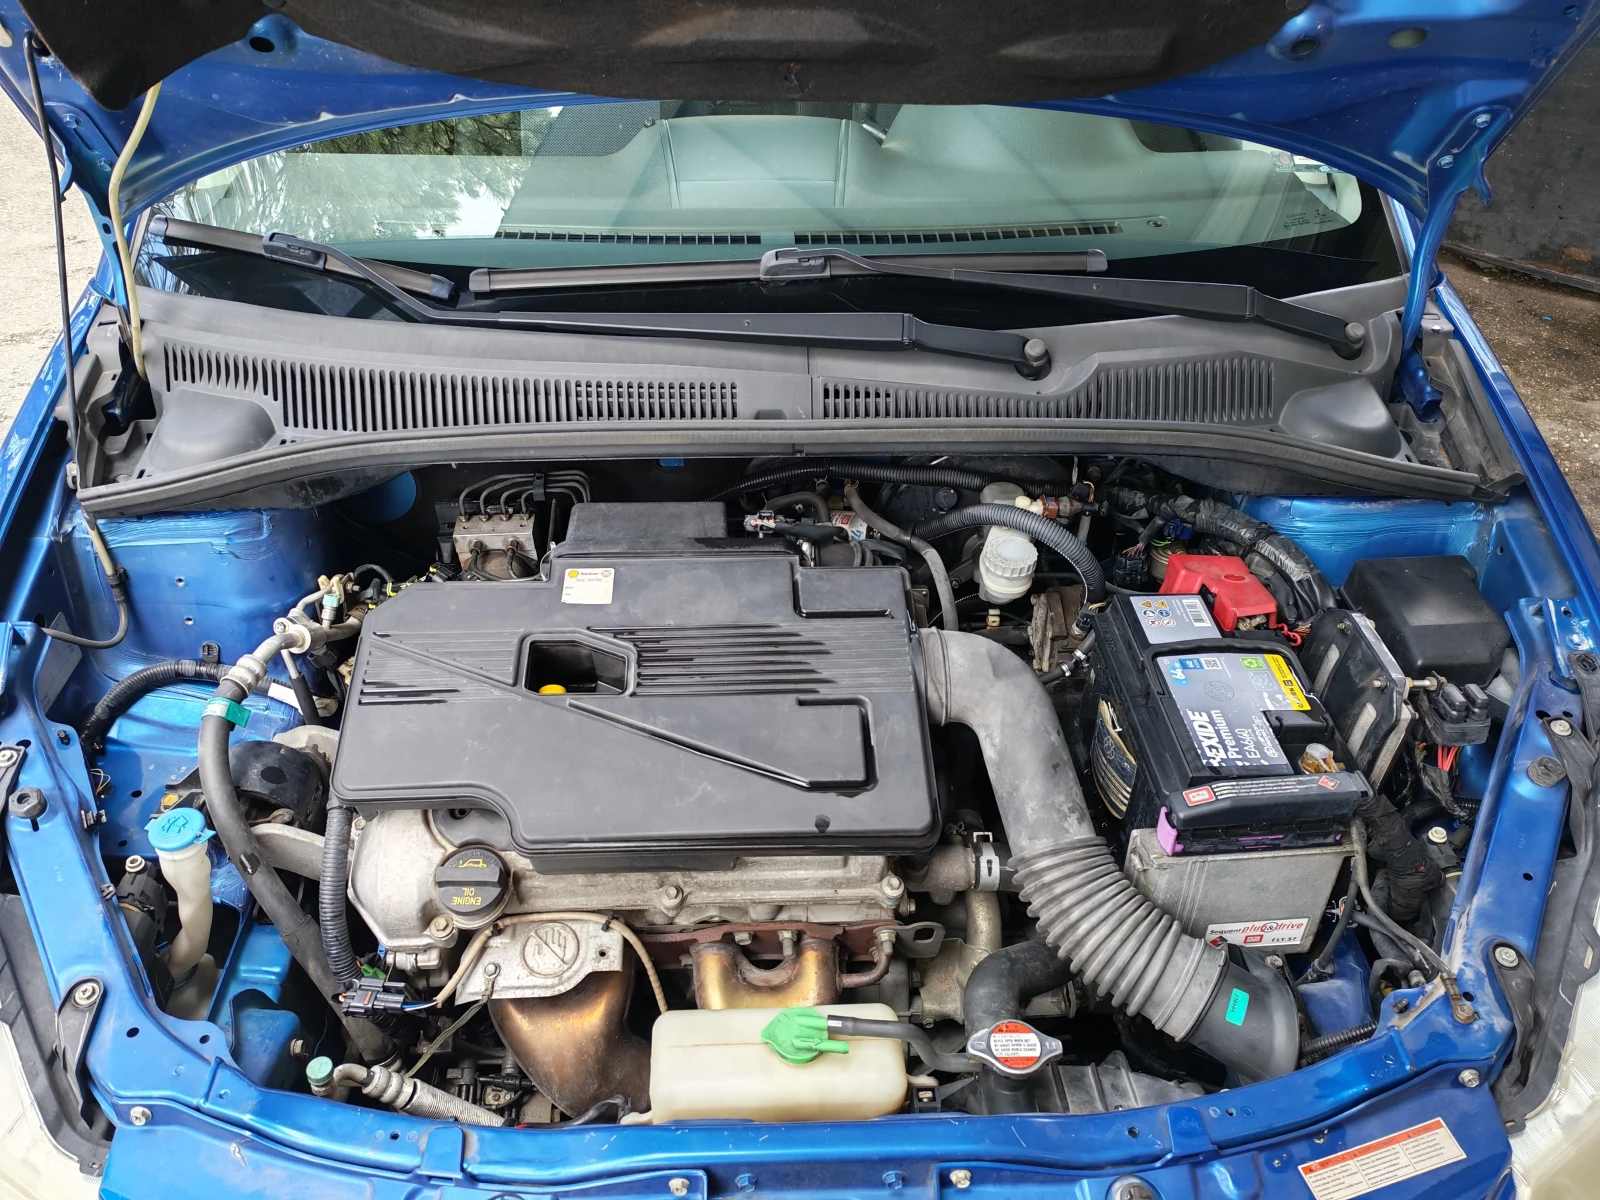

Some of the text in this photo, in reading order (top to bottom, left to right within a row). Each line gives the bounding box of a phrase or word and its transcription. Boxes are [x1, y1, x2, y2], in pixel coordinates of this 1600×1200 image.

[1170, 669, 1185, 679] 64
[1187, 710, 1227, 759] EXIDE
[1211, 710, 1242, 758] Premium
[1235, 728, 1260, 758] EA640
[452, 896, 482, 906] ENGINE
[462, 888, 475, 896] OIL
